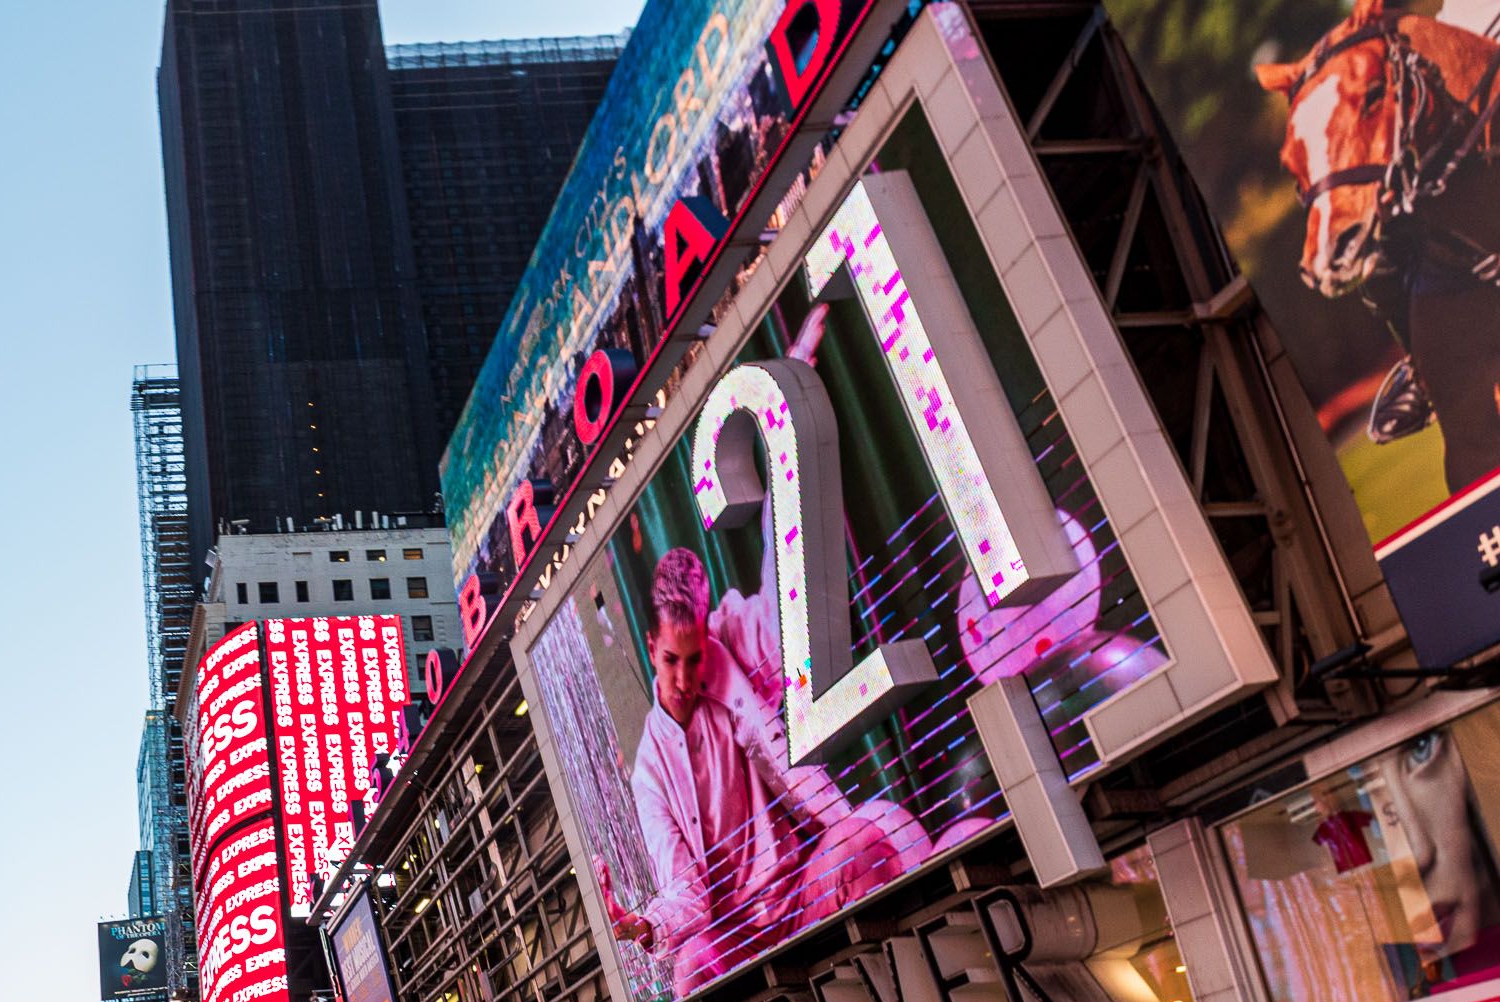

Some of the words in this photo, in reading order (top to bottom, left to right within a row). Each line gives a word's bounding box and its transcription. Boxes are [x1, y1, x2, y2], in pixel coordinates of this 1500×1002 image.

[558, 12, 730, 350] LANDLORD
[574, 146, 628, 259] CITY'S
[692, 179, 1030, 766] 21
[206, 626, 257, 671] EXPRESS
[292, 630, 313, 706] EXPRESS
[337, 628, 361, 704] EXPRESS
[361, 647, 385, 725] EXPRESS
[382, 626, 405, 703] EXPRESS
[210, 673, 261, 715] EXPRESS
[271, 651, 293, 728] EXPRESS
[316, 649, 338, 726] EXPRESS
[216, 762, 269, 801] EXPRESS
[279, 735, 301, 815] EXPRESS
[300, 713, 322, 792] EXPRESS
[325, 734, 348, 814] EXPRESS
[347, 712, 370, 791] EXPRESS
[221, 826, 275, 863] EXPRESS
[287, 824, 311, 905] EXPRESS
[111, 922, 165, 937] PHANTOM
[225, 878, 280, 914] EXPRESS
